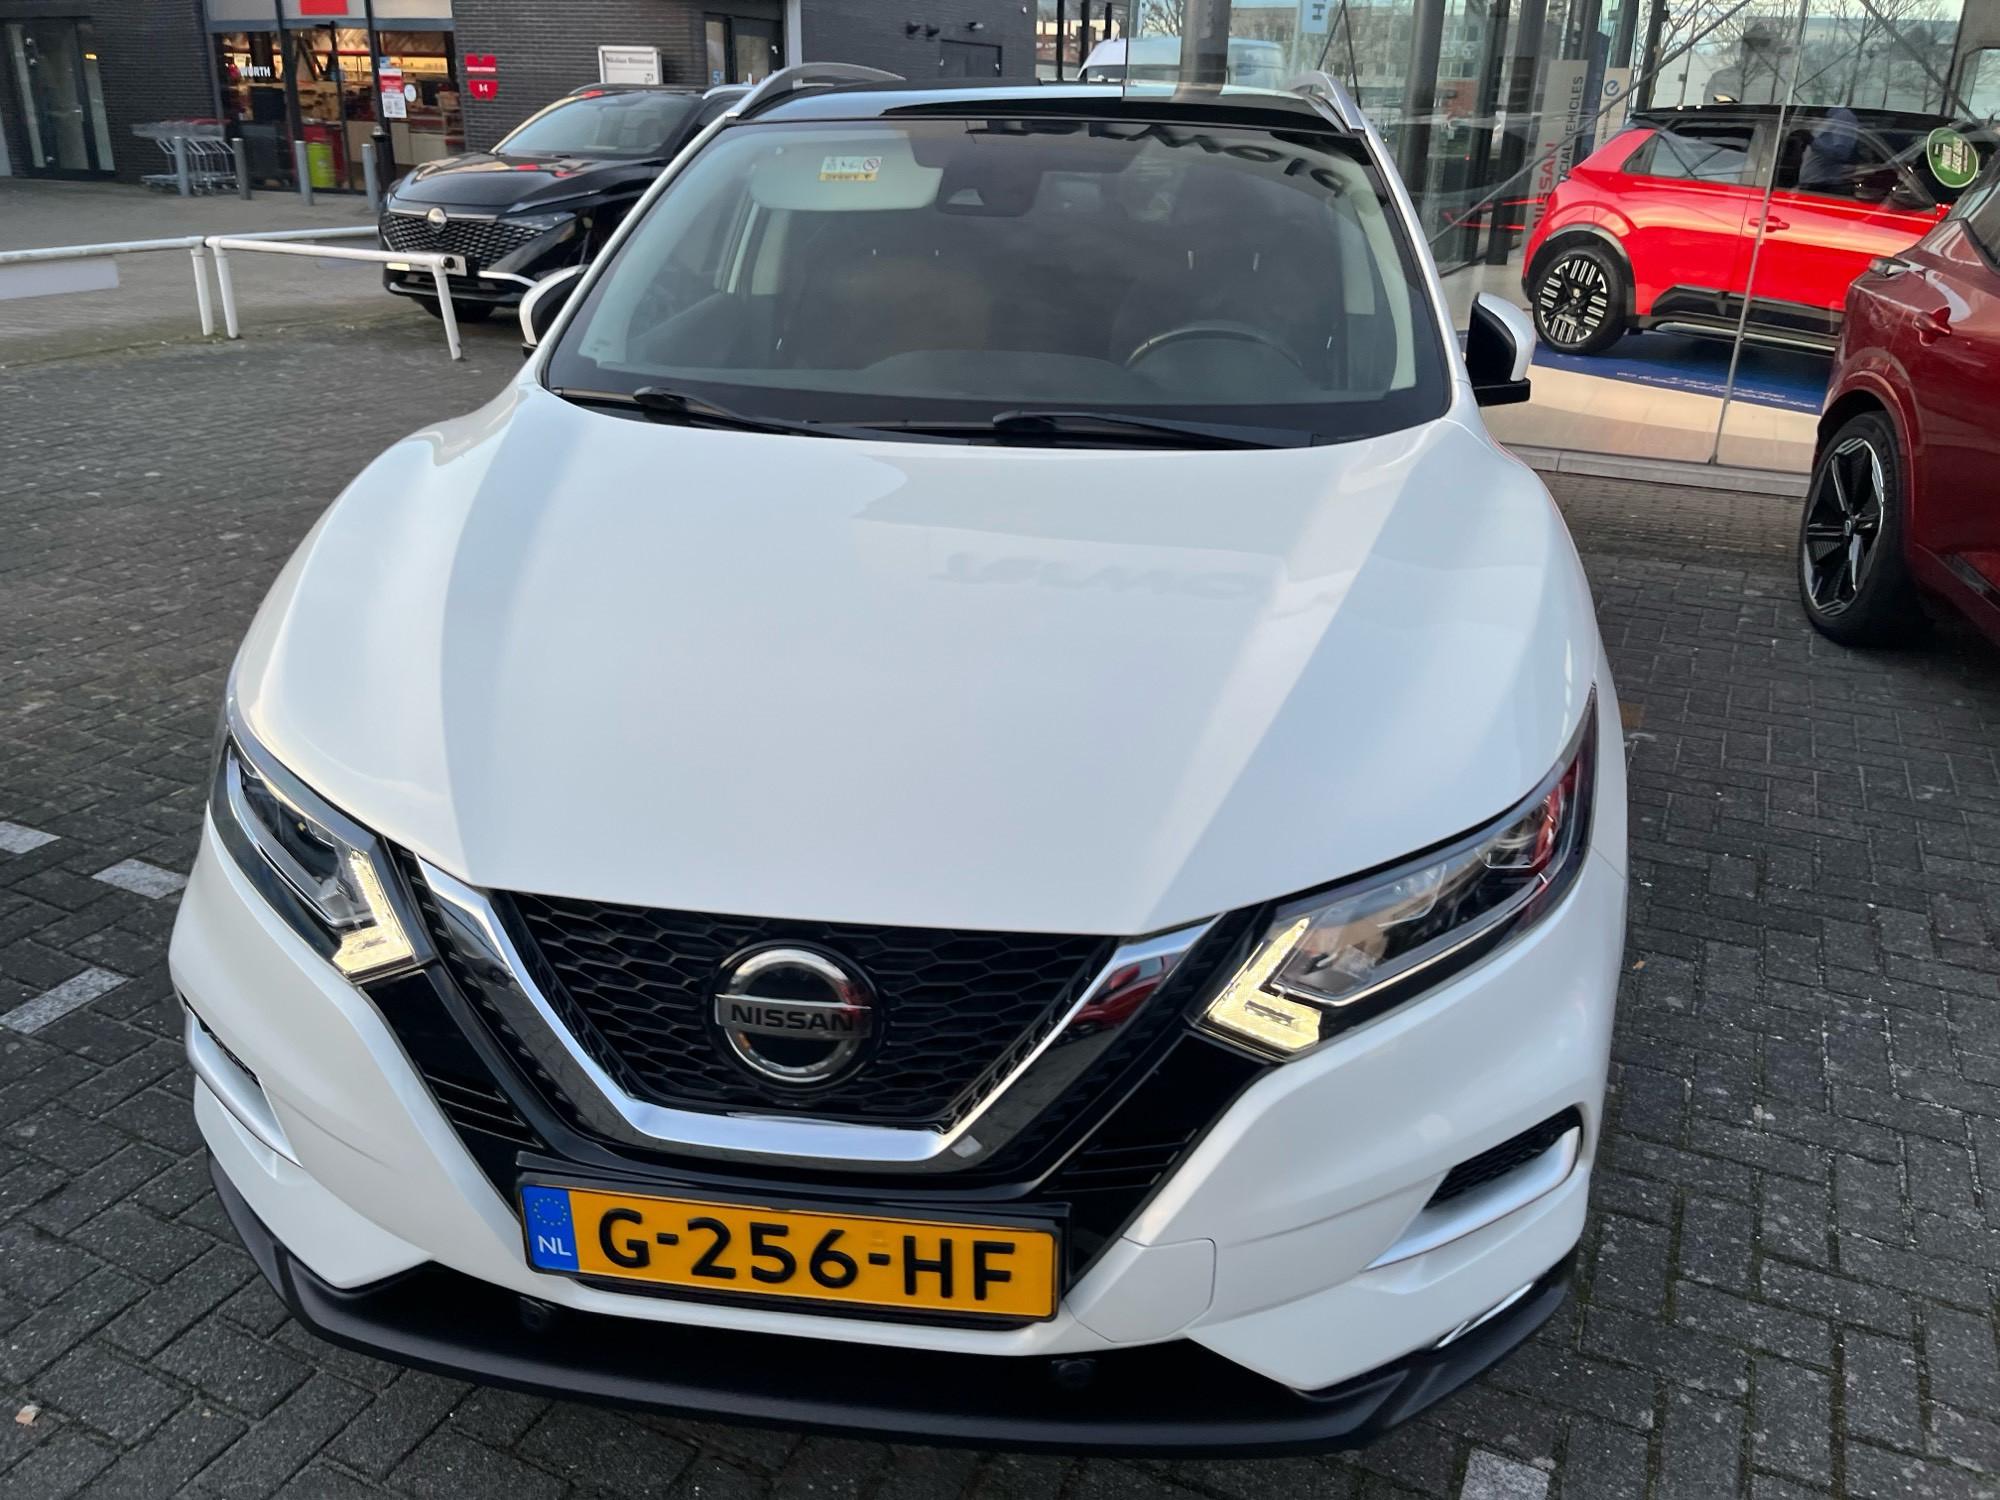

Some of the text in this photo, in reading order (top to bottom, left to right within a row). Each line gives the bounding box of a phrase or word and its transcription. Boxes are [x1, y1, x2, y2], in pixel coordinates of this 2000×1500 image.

[731, 1004, 854, 1032] NISSAN
[538, 1235, 572, 1257] NL
[598, 1208, 1016, 1300] G-256-HF
